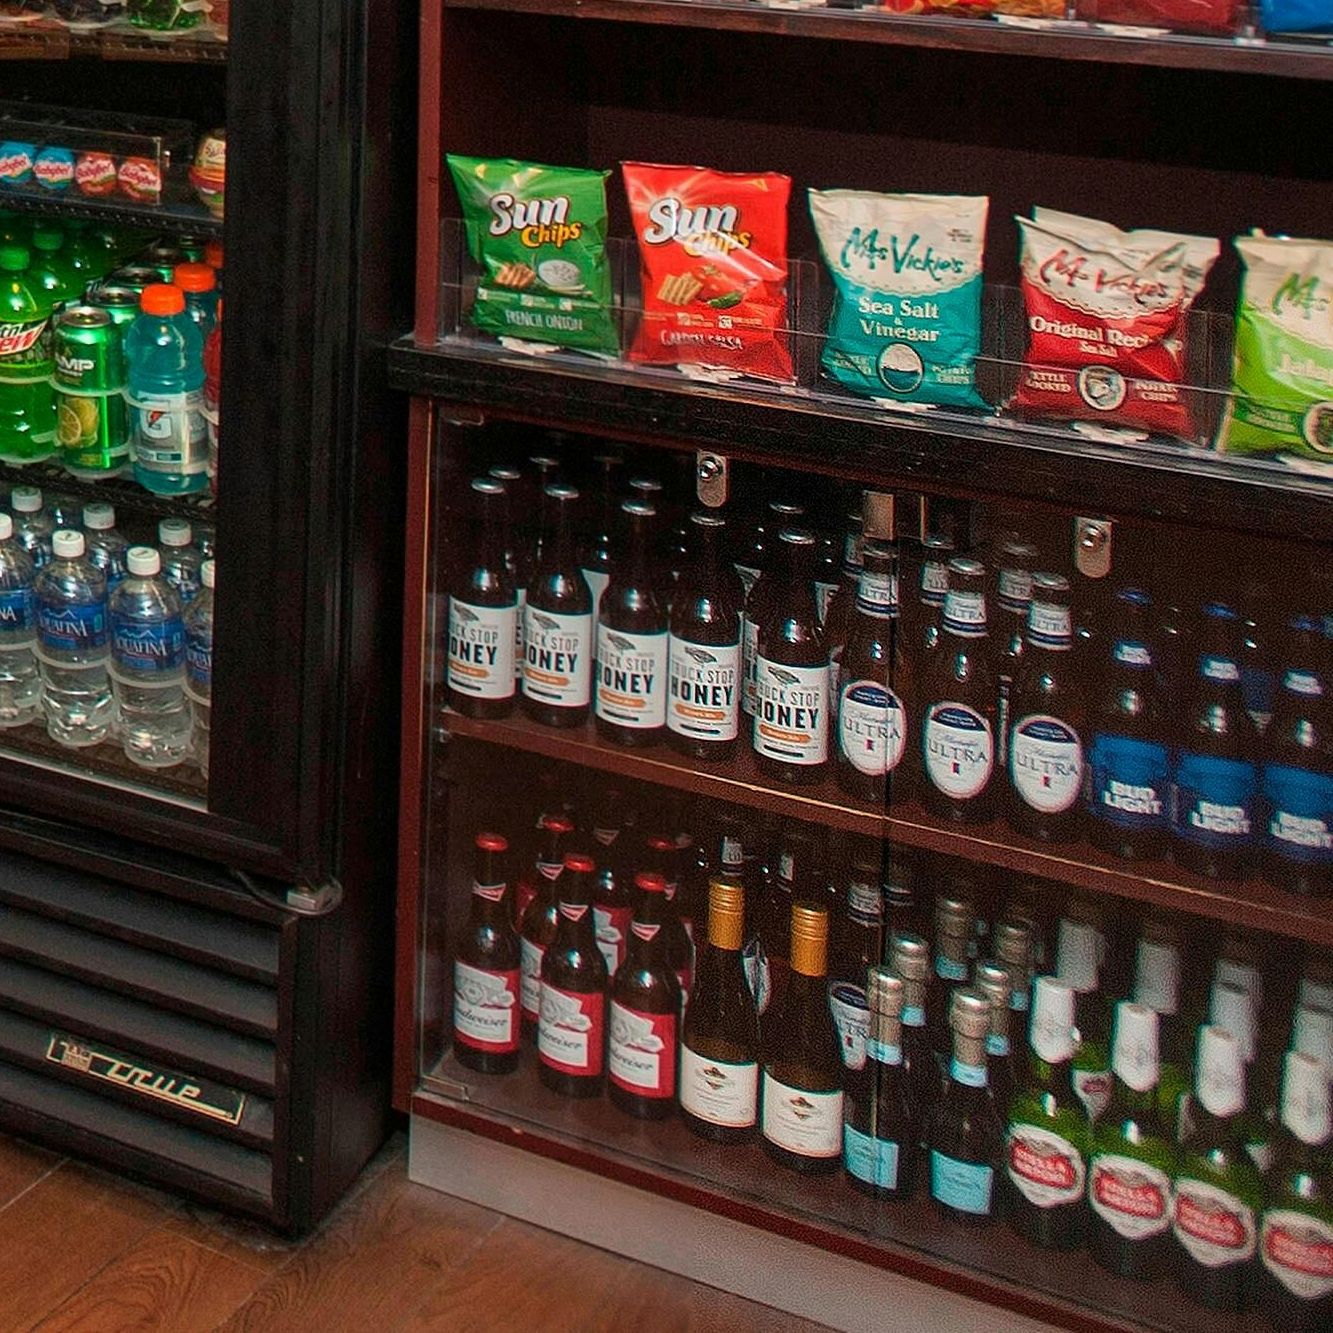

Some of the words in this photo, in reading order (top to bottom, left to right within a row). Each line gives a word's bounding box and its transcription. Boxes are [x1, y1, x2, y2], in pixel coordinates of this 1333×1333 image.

[489, 193, 570, 236] Sun
[644, 197, 740, 245] Sun
[521, 221, 582, 249] Chips
[683, 231, 752, 257] Chips
[890, 235, 965, 281] Vickie's
[858, 296, 896, 318] Sea
[899, 298, 940, 320] Salt
[505, 309, 543, 328] FRENCH
[546, 312, 583, 331] ONION
[860, 319, 940, 343] Vinegar
[1029, 315, 1104, 342] Original
[1106, 329, 1153, 349] Reci
[1080, 341, 1098, 353] Sea
[39, 615, 88, 638] QUAFINA
[470, 630, 499, 644] STOP
[116, 639, 167, 657] QUAFINA
[449, 644, 497, 666] ONEY
[550, 636, 579, 653] STOP
[625, 656, 655, 672] STOP
[707, 669, 734, 686] STOP
[671, 679, 733, 707] HONEY
[790, 691, 820, 707] STOP
[843, 721, 902, 740] ULTRA
[929, 739, 988, 762] ULTRA
[1017, 754, 1078, 776] ULTRA
[454, 1008, 507, 1027] udweiser
[540, 1026, 583, 1050] dweiser
[611, 1046, 654, 1070] dweiser
